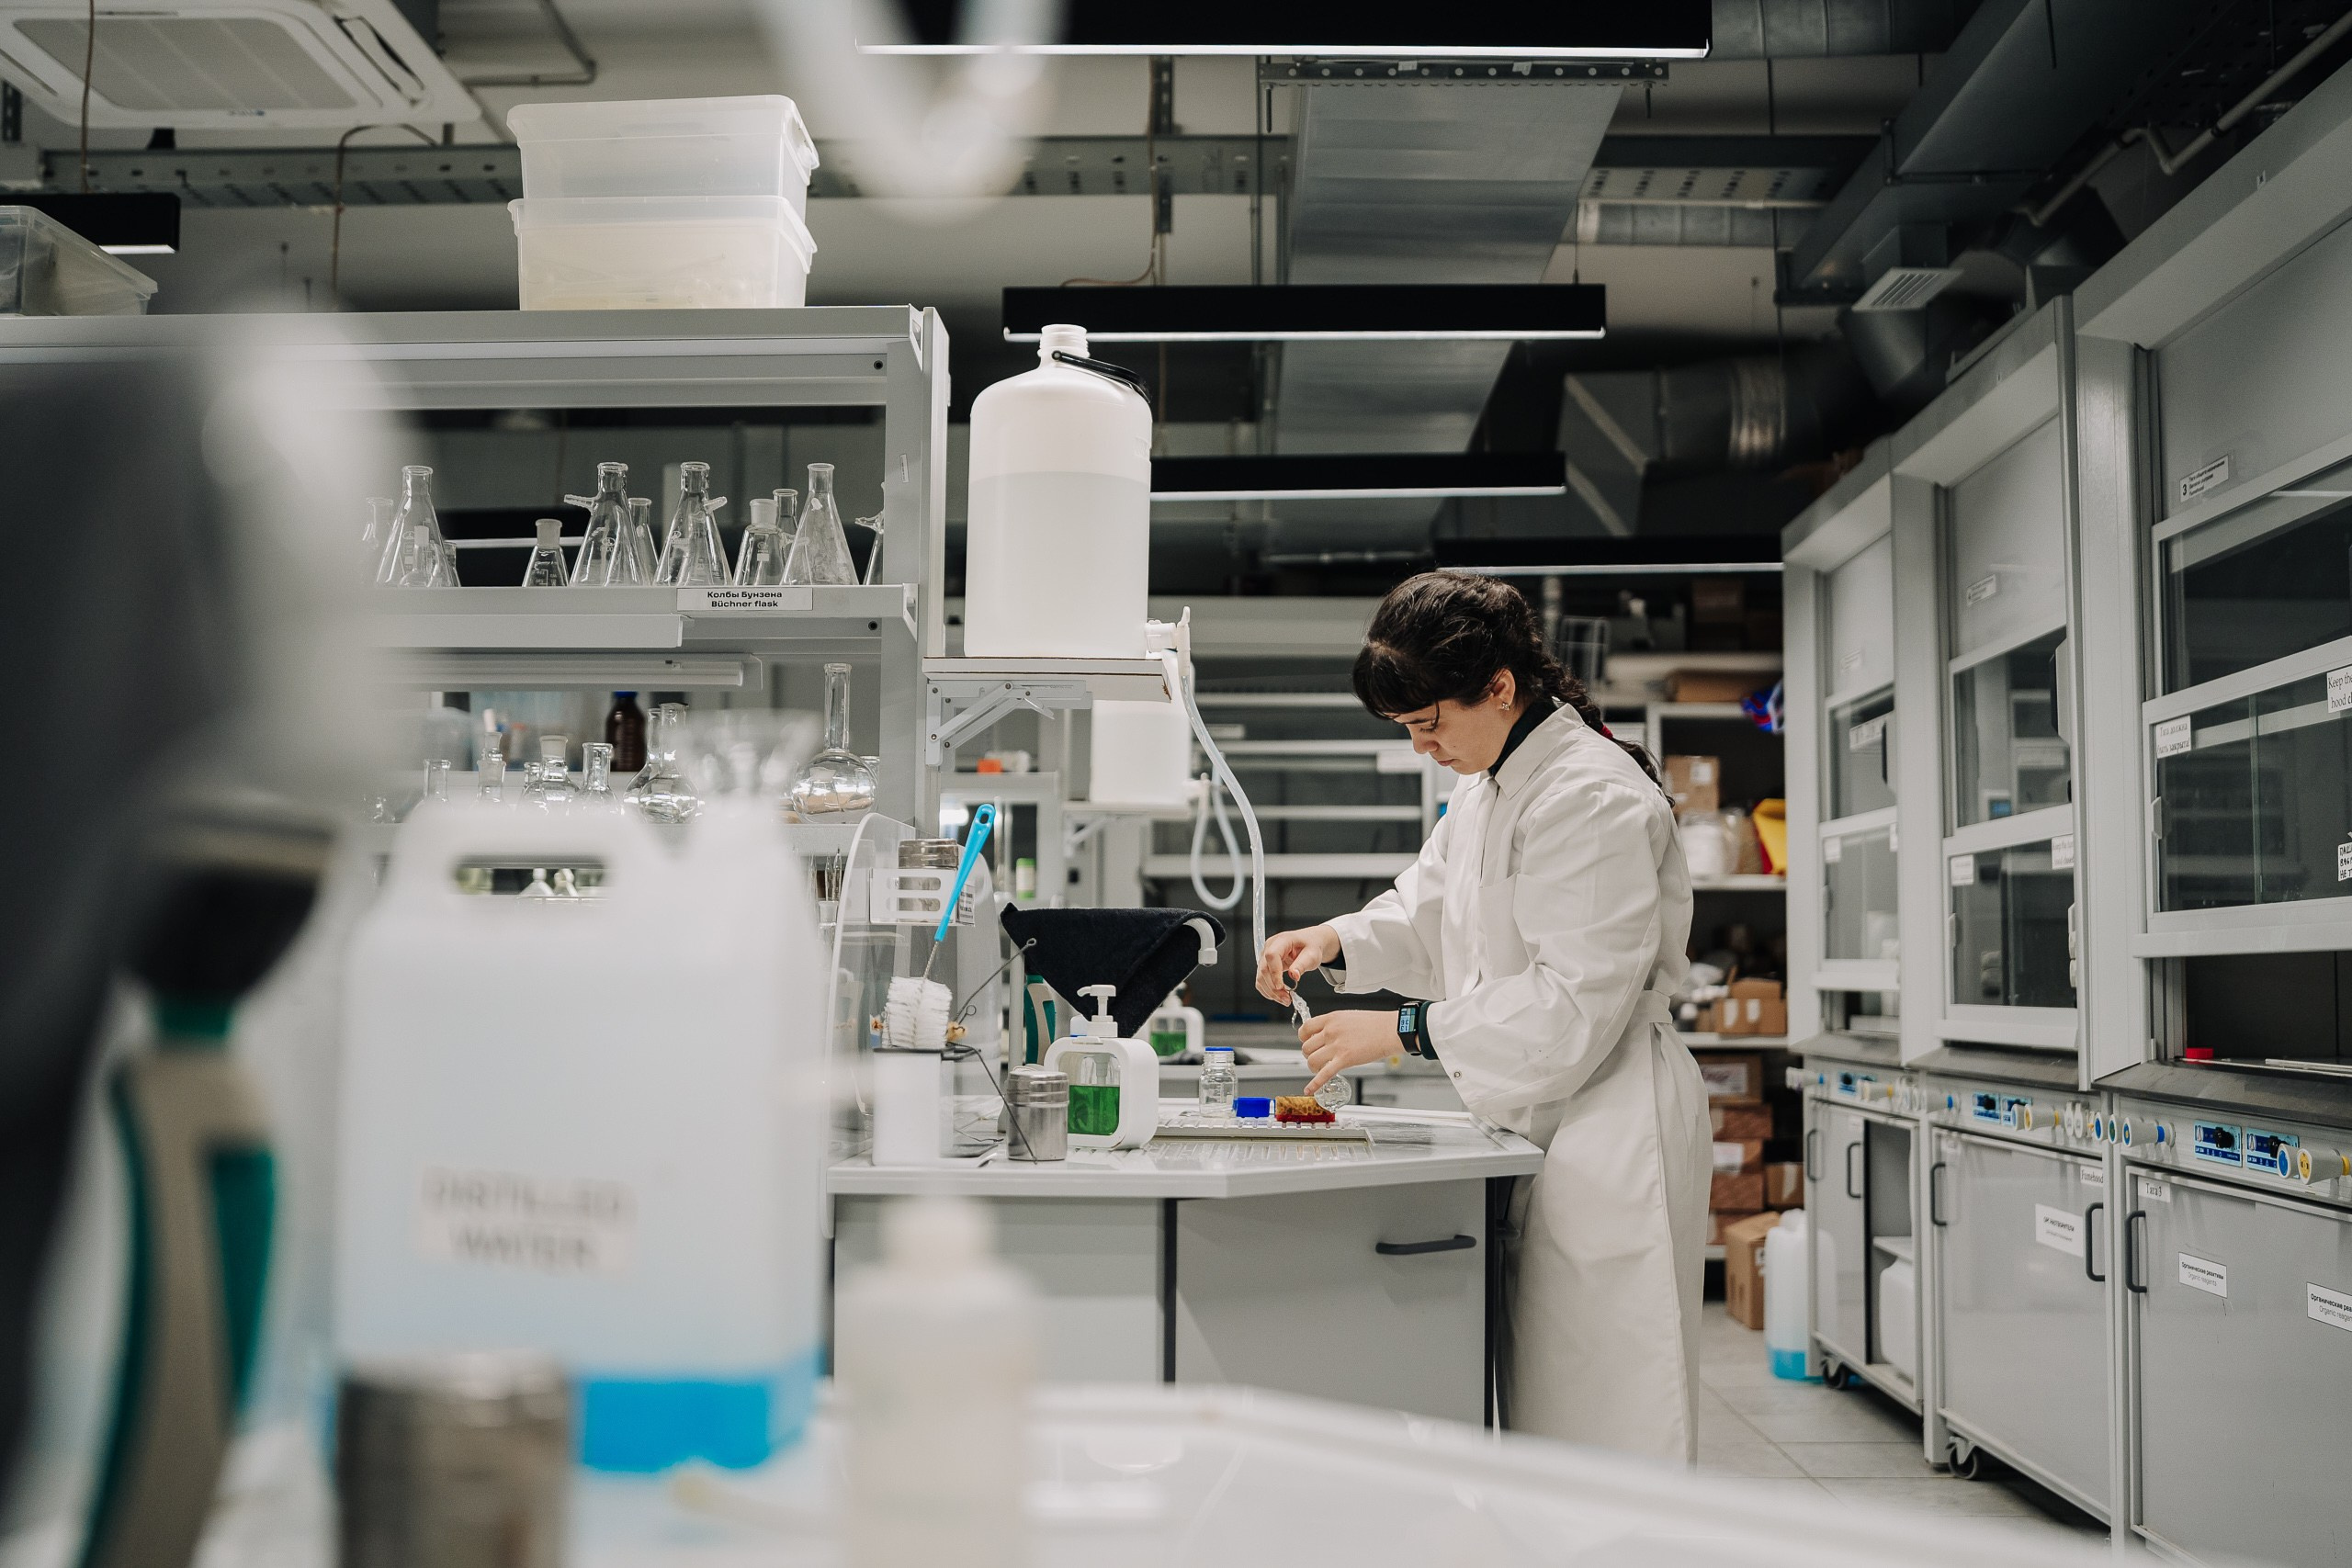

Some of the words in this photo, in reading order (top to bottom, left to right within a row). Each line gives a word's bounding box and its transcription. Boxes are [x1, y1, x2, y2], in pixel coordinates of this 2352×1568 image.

[2182, 483, 2188, 496] 3
[707, 591, 740, 599] Колбы
[741, 591, 783, 600] Бунзена
[711, 600, 752, 608] Büchner
[754, 600, 779, 608] flask
[2328, 676, 2343, 690] Keep
[2331, 693, 2346, 708] hood
[2310, 1292, 2343, 1310] Органические
[2319, 1304, 2336, 1316] Organic
